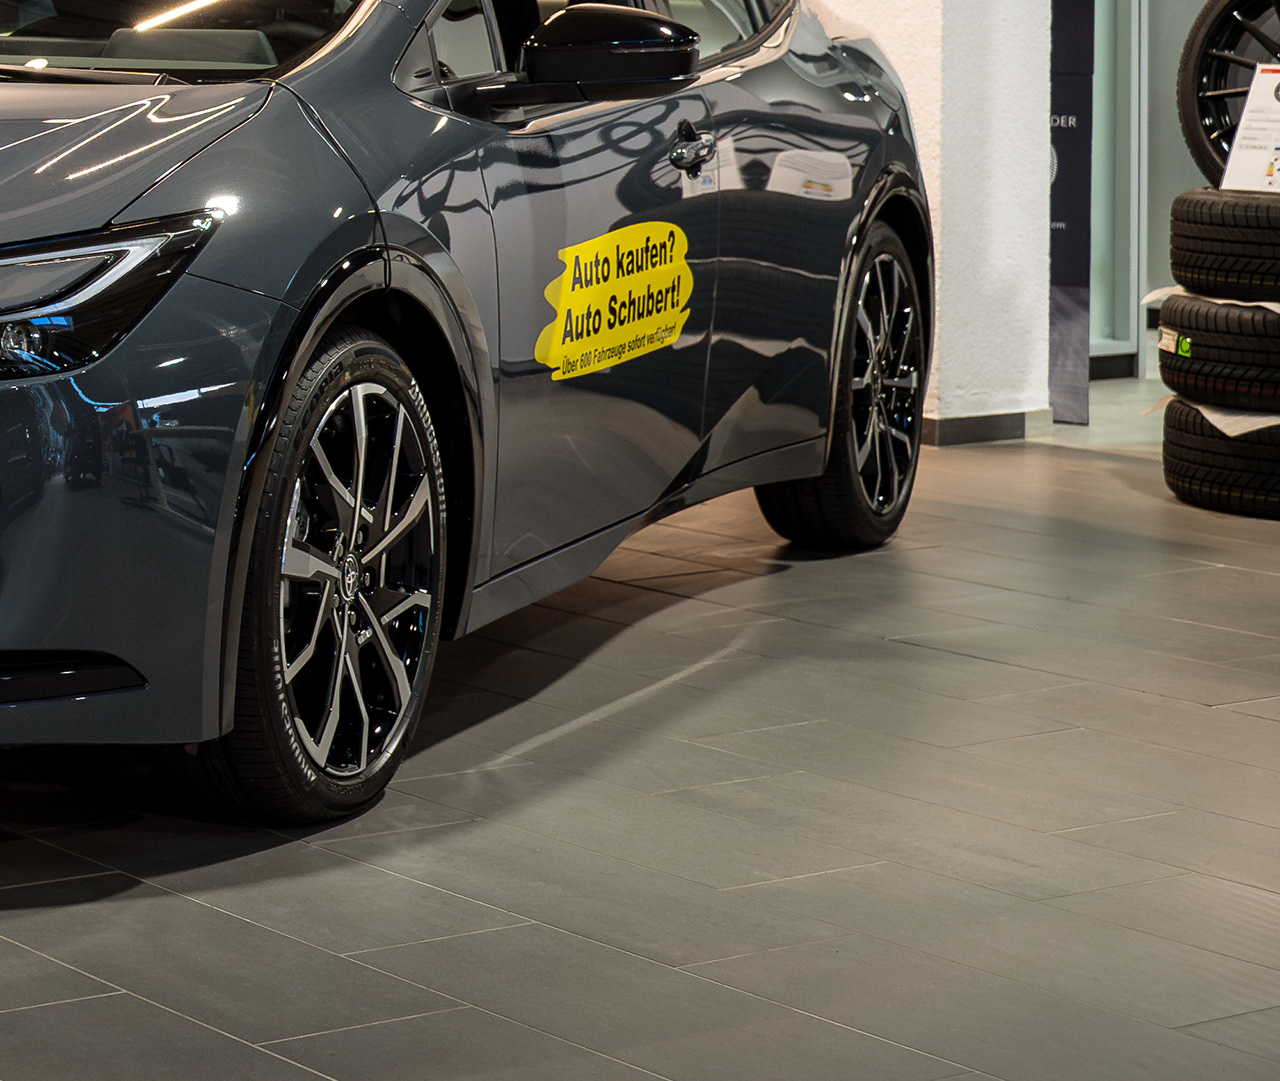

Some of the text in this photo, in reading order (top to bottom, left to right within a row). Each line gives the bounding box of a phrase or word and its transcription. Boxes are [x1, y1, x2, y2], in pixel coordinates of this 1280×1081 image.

[571, 230, 676, 292] Auto kaufen?
[562, 274, 680, 346] Auto Schubert!
[562, 322, 676, 376] Über 600 Fahrzeuge sofort verfügbar!
[408, 377, 446, 524] BRIDGESTONE
